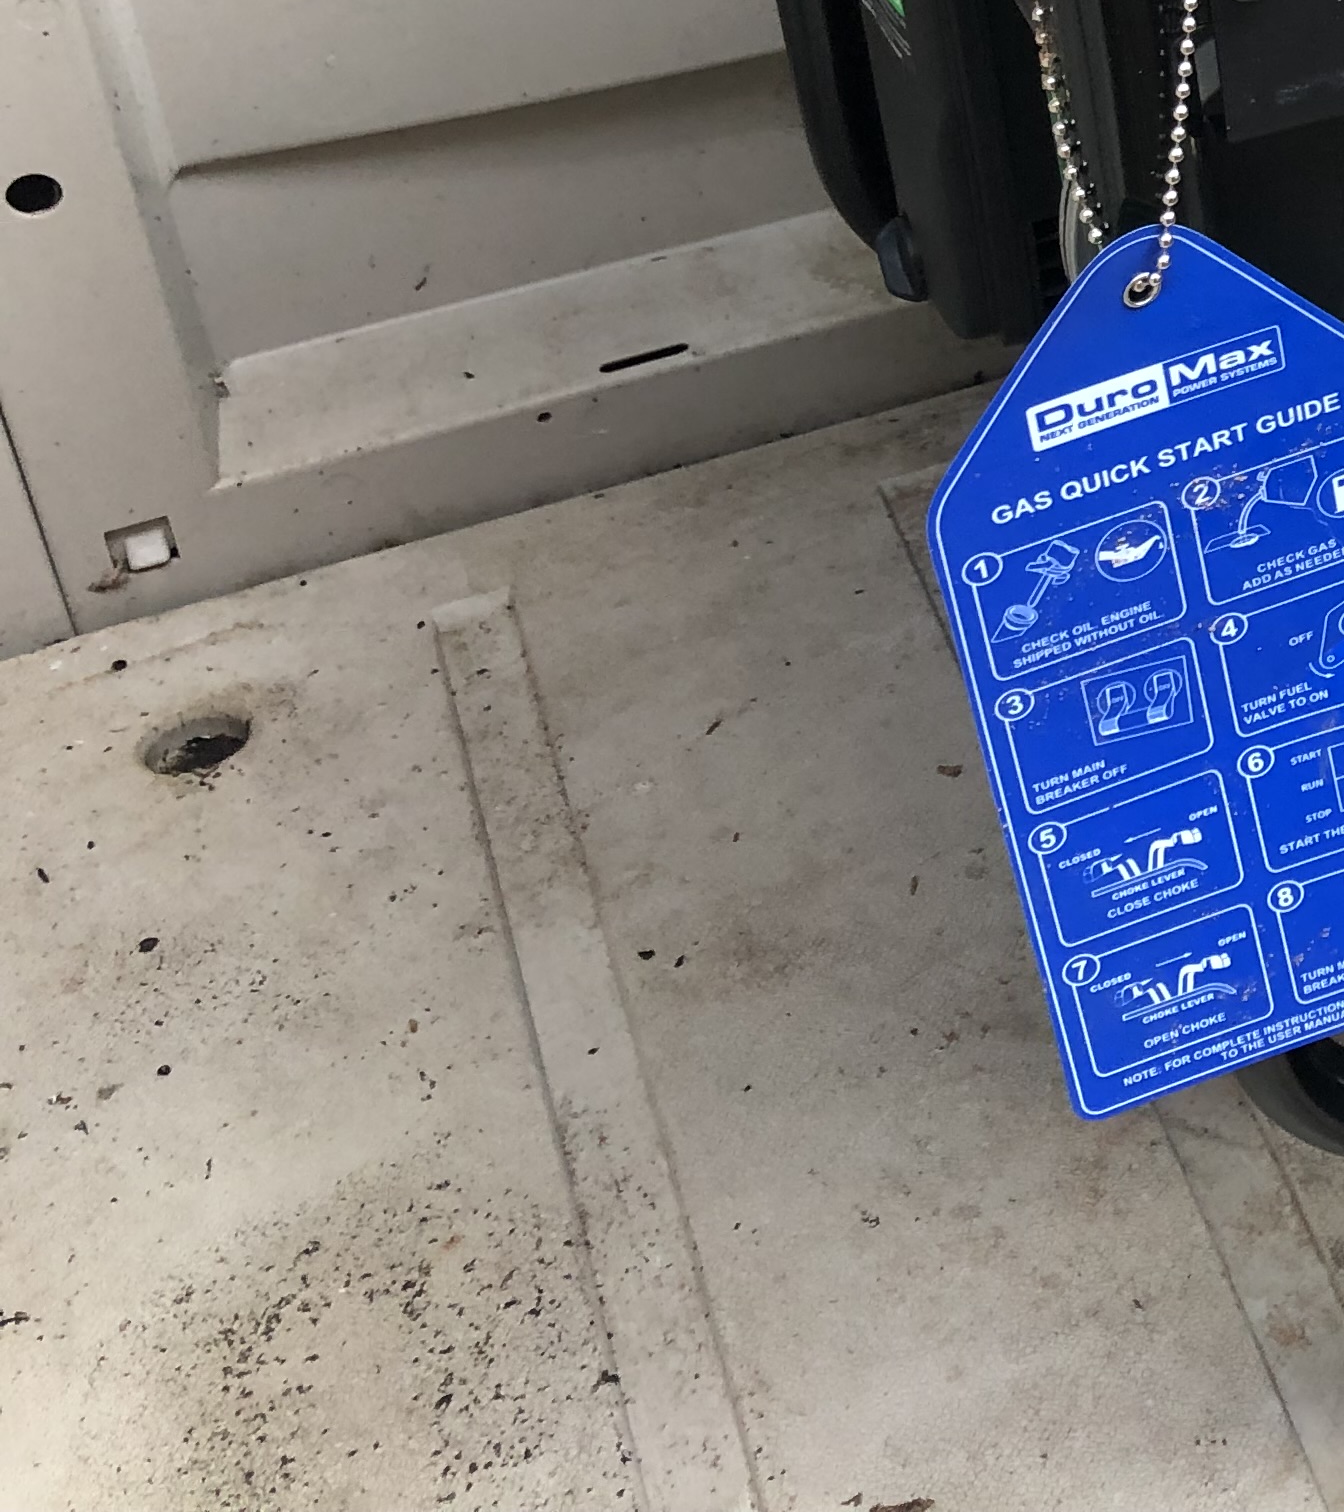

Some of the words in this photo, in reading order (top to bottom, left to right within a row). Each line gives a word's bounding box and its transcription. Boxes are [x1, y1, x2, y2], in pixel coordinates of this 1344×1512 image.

[1172, 376, 1216, 396] POWER
[1220, 357, 1276, 380] SYSTEMS
[1040, 424, 1072, 442] NEXT
[1078, 396, 1158, 428] GENERATION
[991, 491, 1052, 523] GAS
[1060, 456, 1150, 499] QUICK
[1158, 423, 1246, 466] START
[1256, 392, 1340, 432] GUIDE
[1194, 483, 1209, 502] 2
[1257, 550, 1304, 572] CHECK
[1308, 538, 1336, 554] GAS
[975, 560, 990, 579] 1
[1243, 574, 1270, 590] ADD
[1274, 566, 1292, 579] AS
[1021, 630, 1068, 652] CHECK
[1101, 601, 1150, 625] ENGINE
[1222, 619, 1238, 638] 4
[1013, 641, 1071, 667] SHIPPED
[1074, 618, 1134, 646] WITHOUT
[1289, 631, 1312, 645] OFF
[1007, 695, 1023, 715] 3
[1241, 693, 1276, 711] TURN
[1279, 682, 1311, 698] FUEL
[1243, 703, 1285, 723] VALVE
[1288, 696, 1306, 708] TO
[1309, 689, 1328, 701] ON
[1248, 753, 1264, 771] 6
[1290, 748, 1320, 764] START
[1032, 773, 1068, 791] TURN
[1072, 760, 1104, 778] MAIN
[1035, 775, 1099, 804] BREAKER
[1102, 764, 1126, 779] OFF
[1301, 778, 1323, 791] RUN
[1189, 805, 1217, 820] OPEN
[1305, 808, 1331, 822] STOP
[1039, 829, 1054, 848] 5
[1279, 833, 1319, 853] START
[1058, 848, 1100, 868] CLOSED
[1112, 882, 1148, 899] CHOKE
[1151, 869, 1184, 885] LEVER
[1107, 896, 1150, 917] CLOSE
[1154, 878, 1198, 900] CHOKE
[1278, 887, 1294, 906] 8
[1218, 931, 1245, 945] OPEN
[1072, 961, 1087, 979] 7
[1300, 964, 1333, 981] TURN
[1090, 972, 1130, 992] CLOSED
[1142, 1005, 1178, 1023] CHOKE
[1181, 993, 1213, 1009] LEVER
[1144, 1029, 1178, 1047] OPEN
[1181, 1012, 1225, 1033] CHOKE
[1164, 1054, 1190, 1070] FOR
[1193, 1029, 1260, 1059] COMPLETE
[1220, 1047, 1239, 1060] TO
[1240, 1038, 1264, 1052] THE
[1268, 1026, 1300, 1043] USER
